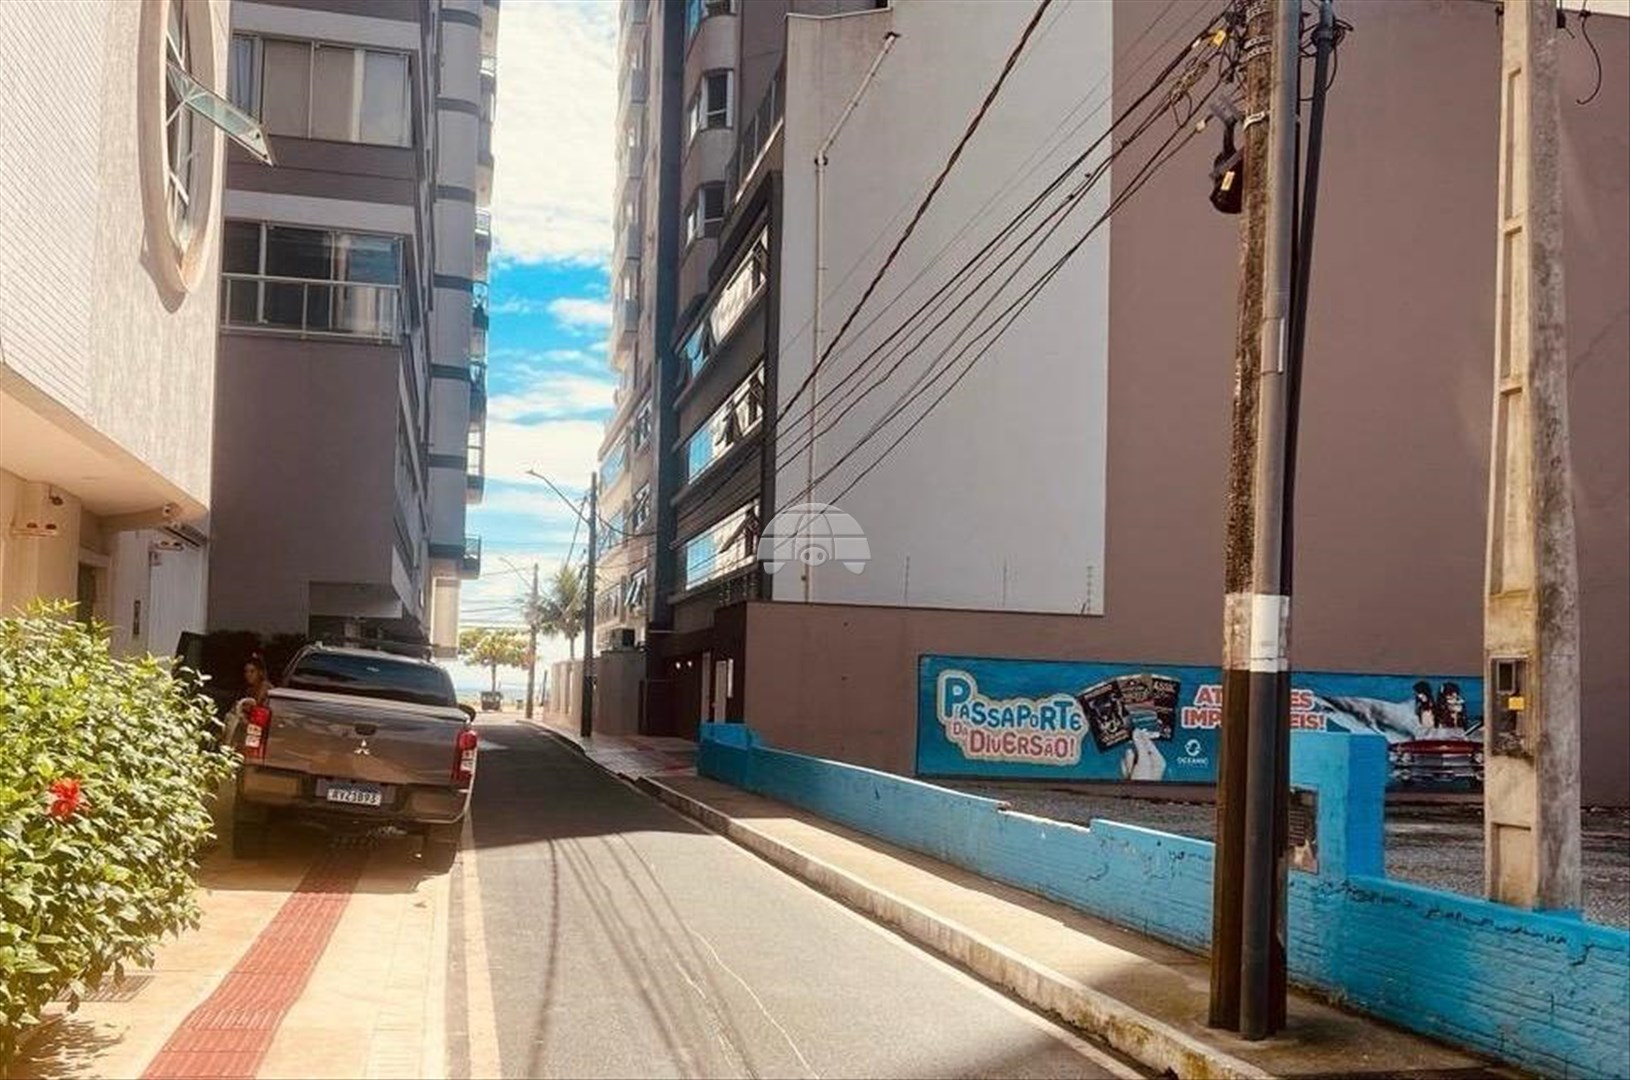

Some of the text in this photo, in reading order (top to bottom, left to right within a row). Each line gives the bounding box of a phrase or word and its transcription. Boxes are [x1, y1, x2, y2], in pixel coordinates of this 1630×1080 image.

[944, 676, 1083, 732] PASSAPORTE
[1194, 685, 1315, 710] ATES
[1182, 707, 1327, 731] IMPEIS!
